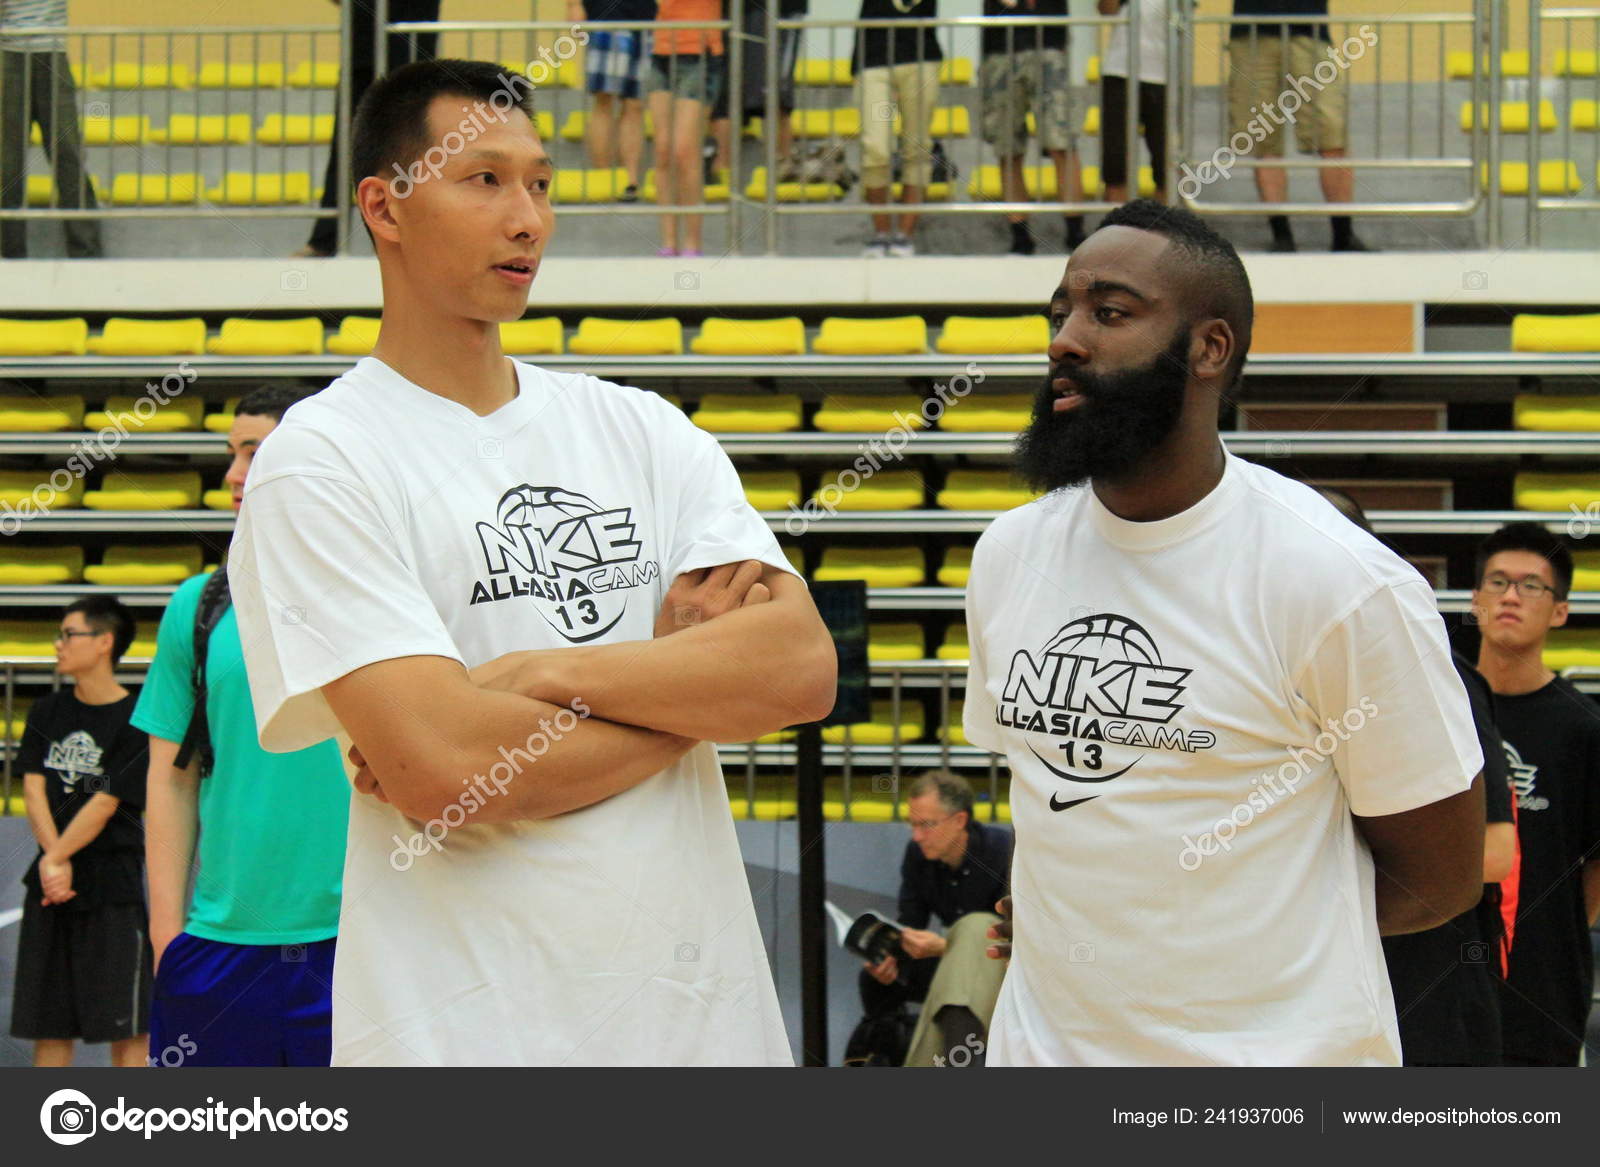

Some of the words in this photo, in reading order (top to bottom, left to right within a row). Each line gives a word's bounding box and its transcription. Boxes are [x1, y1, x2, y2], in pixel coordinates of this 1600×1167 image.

[555, 599, 600, 630] 13
[1002, 649, 1194, 724] NIKE
[1103, 721, 1216, 753] CAMP
[1059, 740, 1103, 770] 13
